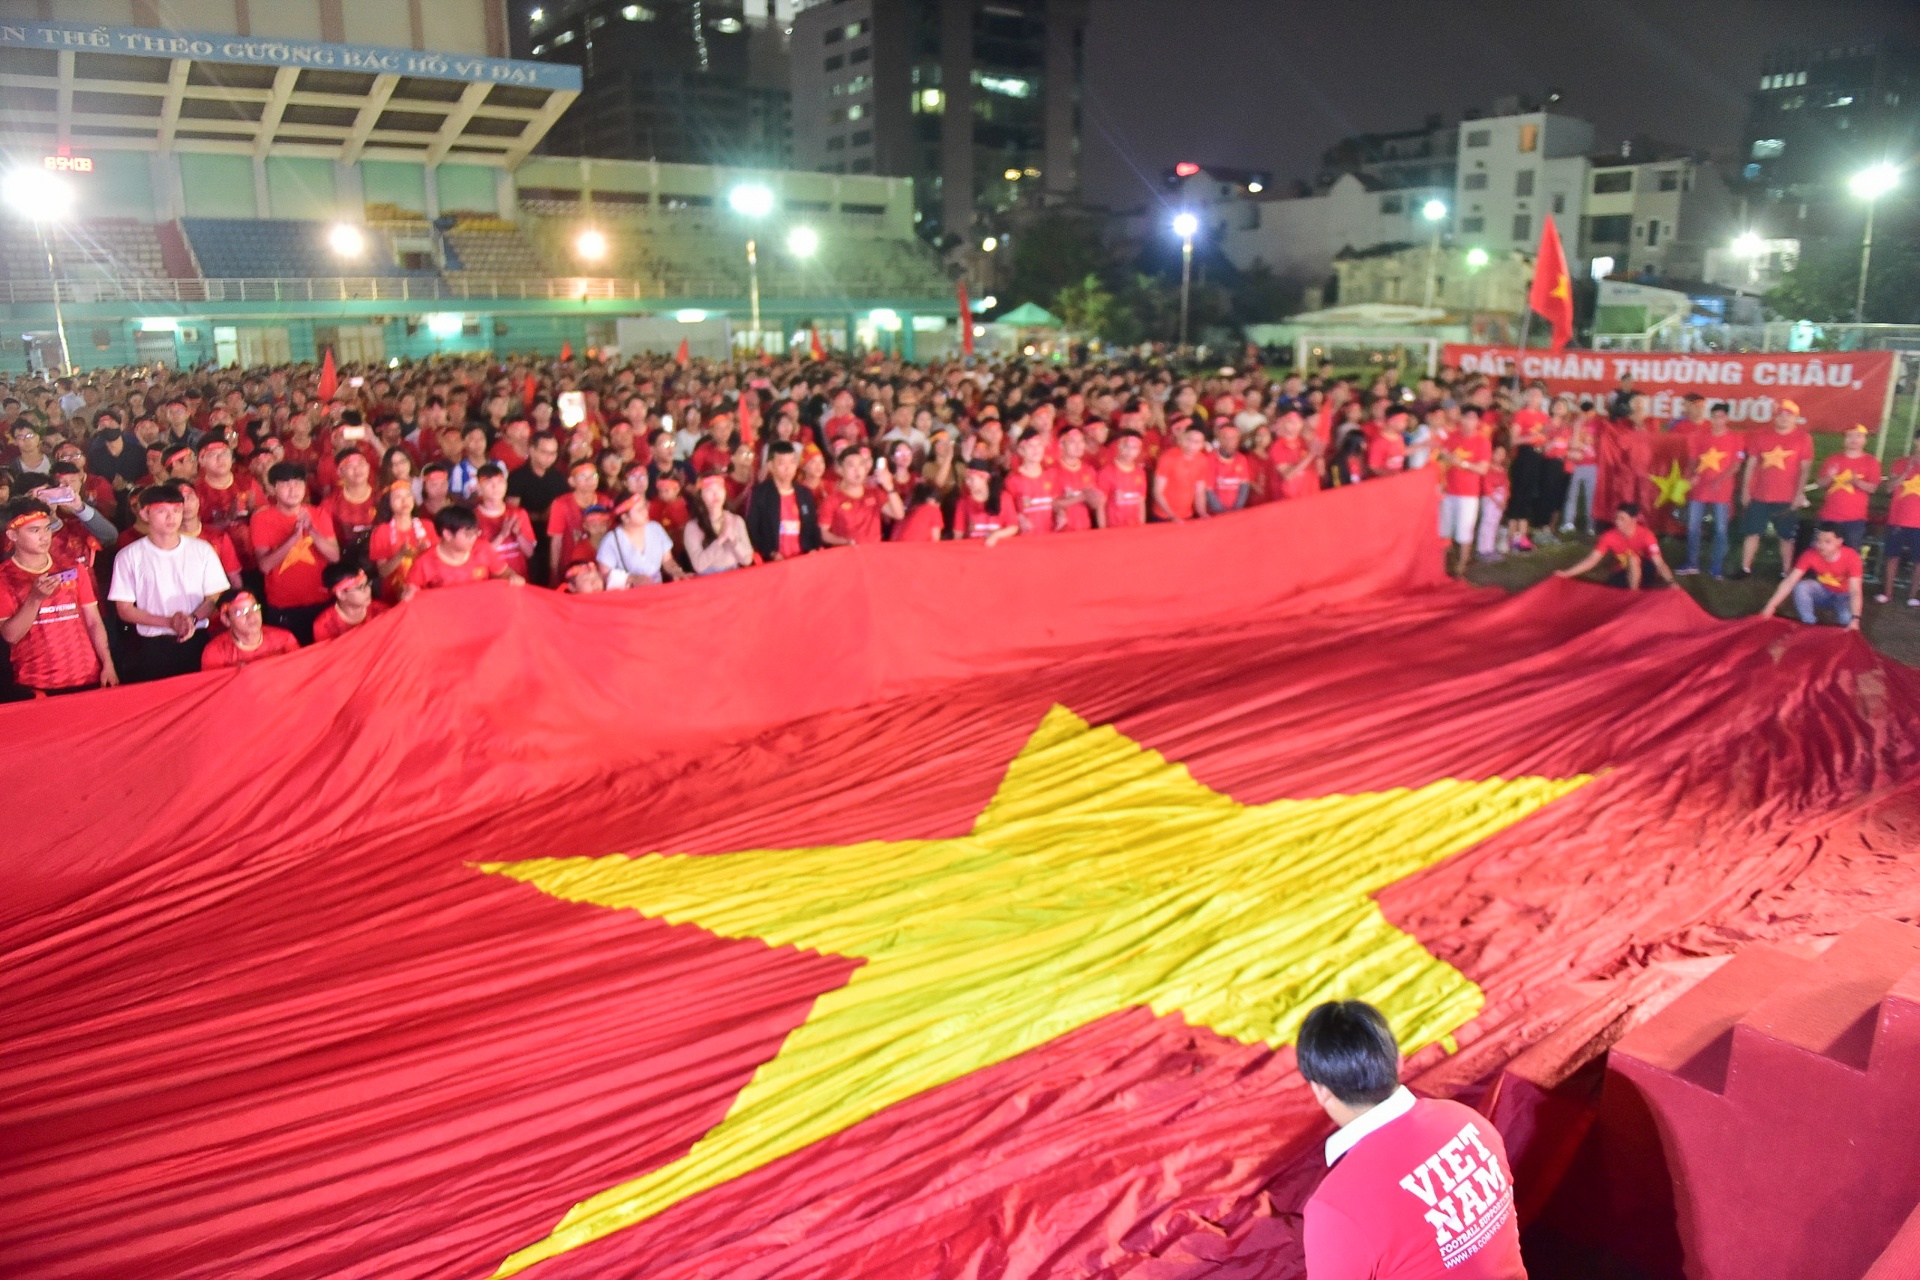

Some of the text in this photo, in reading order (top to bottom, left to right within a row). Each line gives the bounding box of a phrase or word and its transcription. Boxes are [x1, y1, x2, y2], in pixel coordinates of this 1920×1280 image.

[38, 25, 111, 48] THỂ
[119, 32, 214, 56] THEO
[342, 48, 400, 71] BÁC
[1522, 353, 1605, 381] CHÂN
[1752, 358, 1864, 391] CHÂU,
[1399, 1122, 1491, 1207] VIET
[1423, 1154, 1508, 1246] NAM
[1439, 1225, 1481, 1256] FOOTBALL
